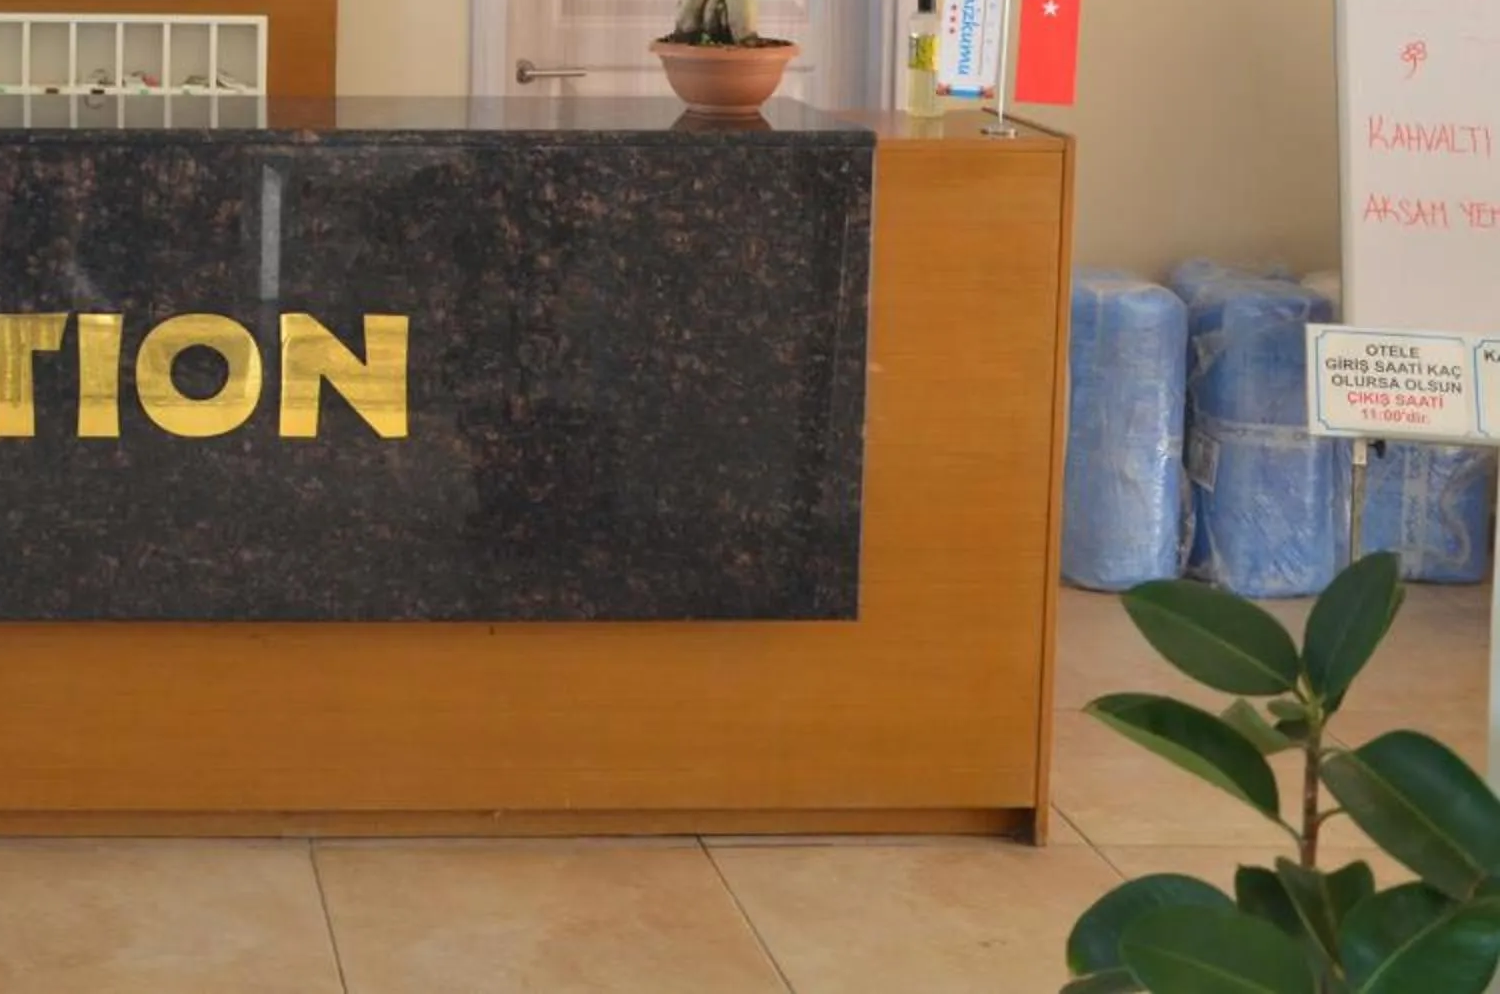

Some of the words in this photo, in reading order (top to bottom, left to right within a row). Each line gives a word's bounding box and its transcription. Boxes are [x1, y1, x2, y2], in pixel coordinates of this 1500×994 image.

[1368, 115, 1492, 158] KAHVALTI
[1365, 344, 1421, 359] OTELE
[1325, 357, 1370, 374] GİRİŞ
[1374, 359, 1423, 375] SAATİ
[1427, 364, 1462, 380] KAÇ
[1331, 374, 1400, 389] OLURSA
[1405, 379, 1463, 394] OLSUN
[1347, 391, 1391, 407] ÇIKIŞ
[1395, 393, 1445, 408] SAATİ
